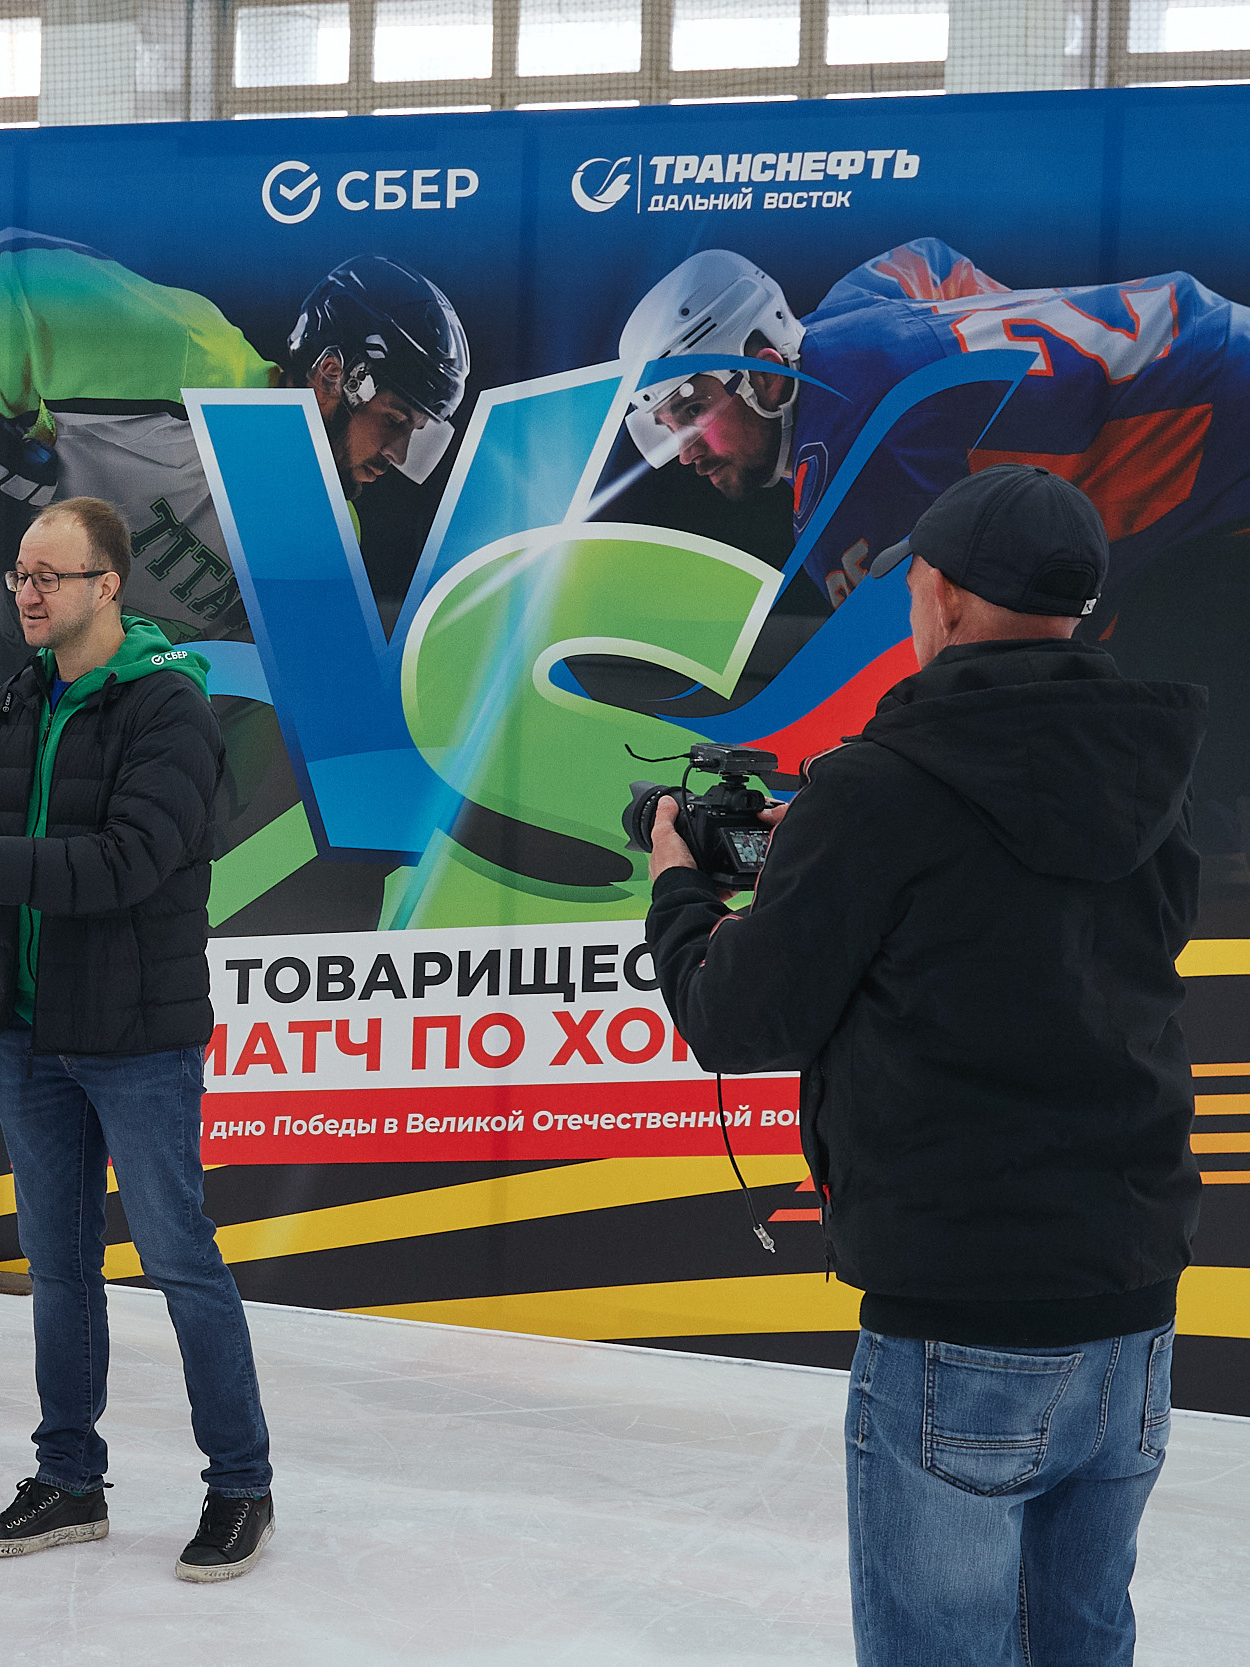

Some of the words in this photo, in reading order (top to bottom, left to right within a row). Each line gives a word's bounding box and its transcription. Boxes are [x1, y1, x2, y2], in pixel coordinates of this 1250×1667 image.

[649, 149, 921, 185] ТРАНСНЕФТЬ
[336, 168, 480, 211] СБЕР
[647, 187, 753, 212] ДАЛЬНИЙ
[762, 190, 852, 210] ВОСТОК
[130, 497, 242, 624] TITA
[164, 650, 188, 661] СБЕР
[225, 942, 662, 1005] ТОВАРИЩЕС
[411, 1011, 526, 1071] ПО
[209, 1118, 266, 1140] дню
[273, 1113, 377, 1138] Победы
[383, 1117, 399, 1134] в
[406, 1109, 525, 1134] Великой
[532, 1104, 752, 1132] Отечественной
